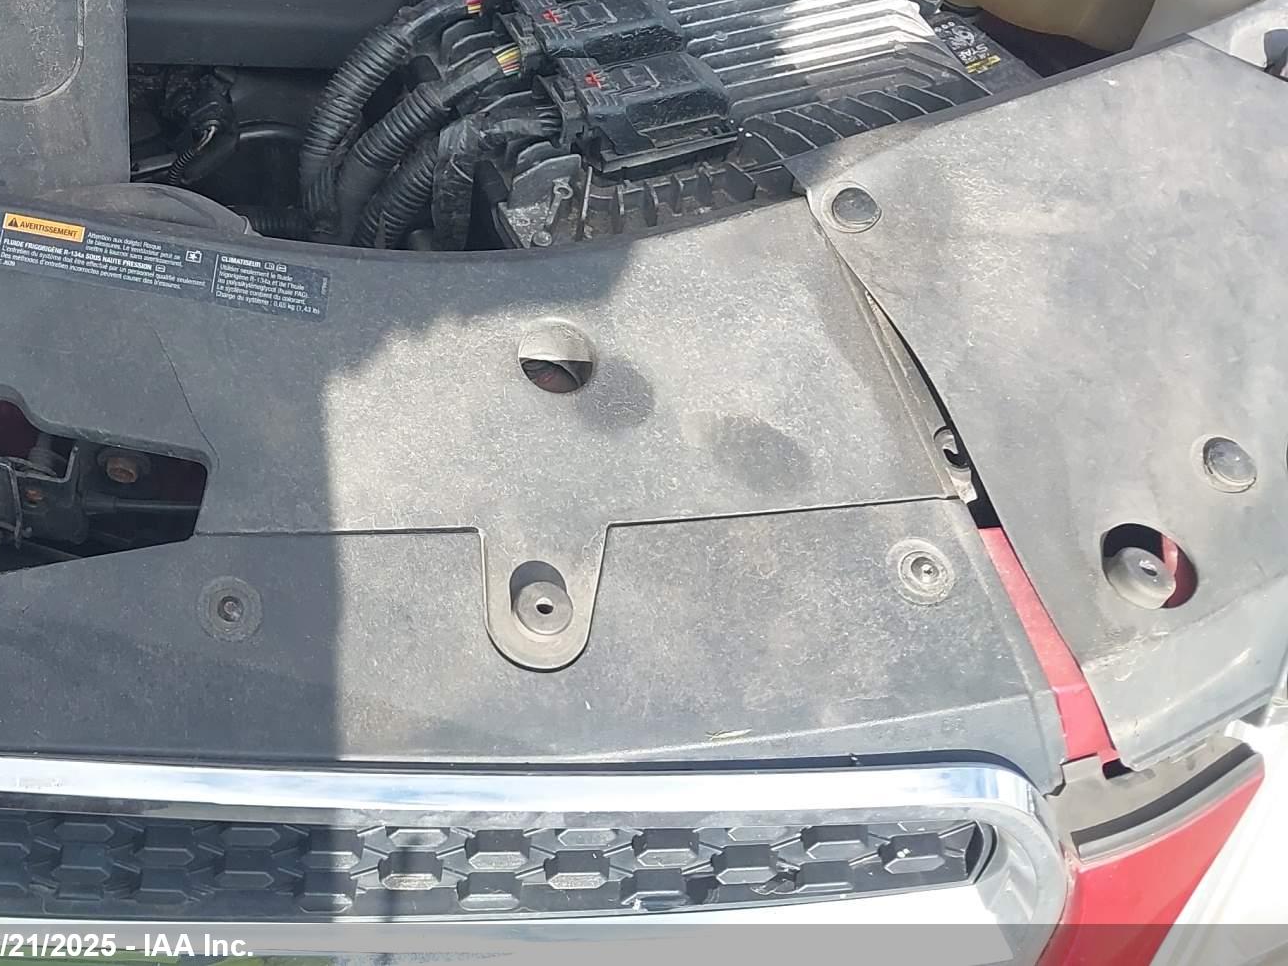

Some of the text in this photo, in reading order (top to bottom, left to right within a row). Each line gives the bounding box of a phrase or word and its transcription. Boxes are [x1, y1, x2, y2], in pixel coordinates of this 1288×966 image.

[19, 221, 79, 238] AVERTISSEMENT
[4, 239, 24, 247] FLUIDE
[86, 253, 102, 261] SOUS
[103, 257, 122, 265] HAUTE
[123, 260, 152, 270] PRESSION
[221, 256, 261, 268] CLIMATISEUR
